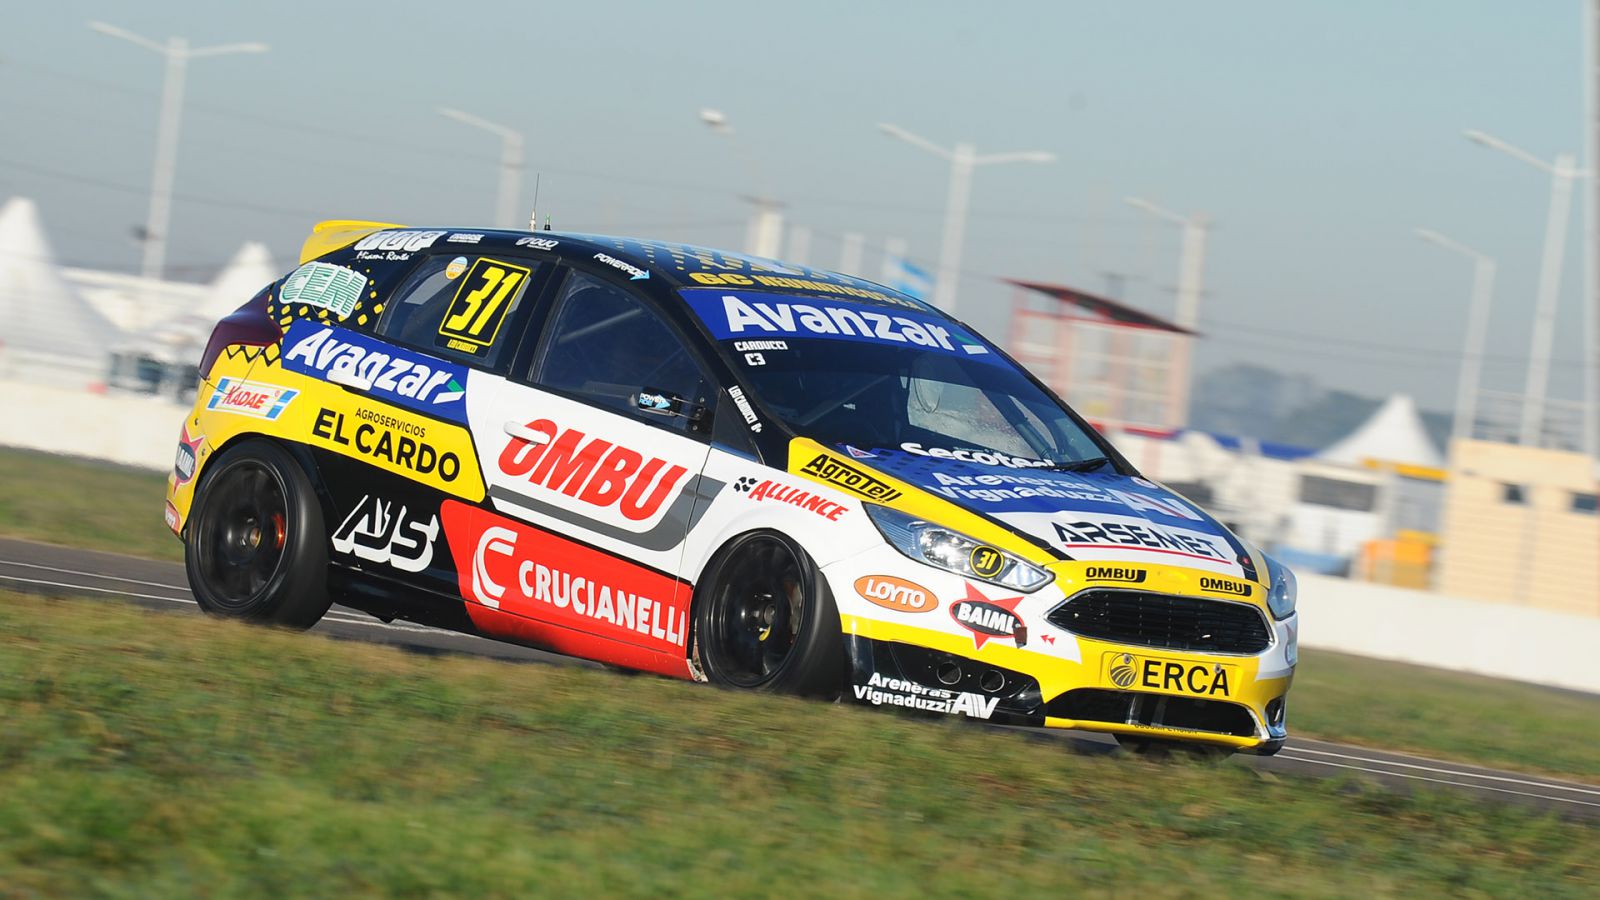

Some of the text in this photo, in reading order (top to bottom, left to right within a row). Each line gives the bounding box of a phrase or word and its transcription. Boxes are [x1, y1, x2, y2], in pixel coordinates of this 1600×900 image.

[689, 272, 754, 285] GC
[446, 266, 523, 335] 31
[722, 295, 954, 351] Avanzar
[734, 341, 788, 351] CARDUCCI
[744, 353, 766, 366] C3
[285, 328, 452, 401] Avanzar
[222, 385, 269, 410] KADAE
[355, 407, 426, 438] AGROSERVICIOS
[312, 408, 460, 483] EL CARDO
[498, 419, 688, 521] OMBU
[932, 472, 1101, 493] Areneras
[748, 480, 849, 522] ALLIANCE
[1051, 521, 1226, 560] ARSEMET
[976, 551, 998, 569] 31
[1086, 567, 1136, 580] OMBU
[865, 579, 926, 608] LOYTO
[1200, 577, 1243, 593] OMBU
[519, 560, 686, 647] CRUCIANELLI
[868, 672, 951, 698] Areneras
[1143, 660, 1229, 696] ERCA
[853, 685, 954, 713] Vignaduzzi
